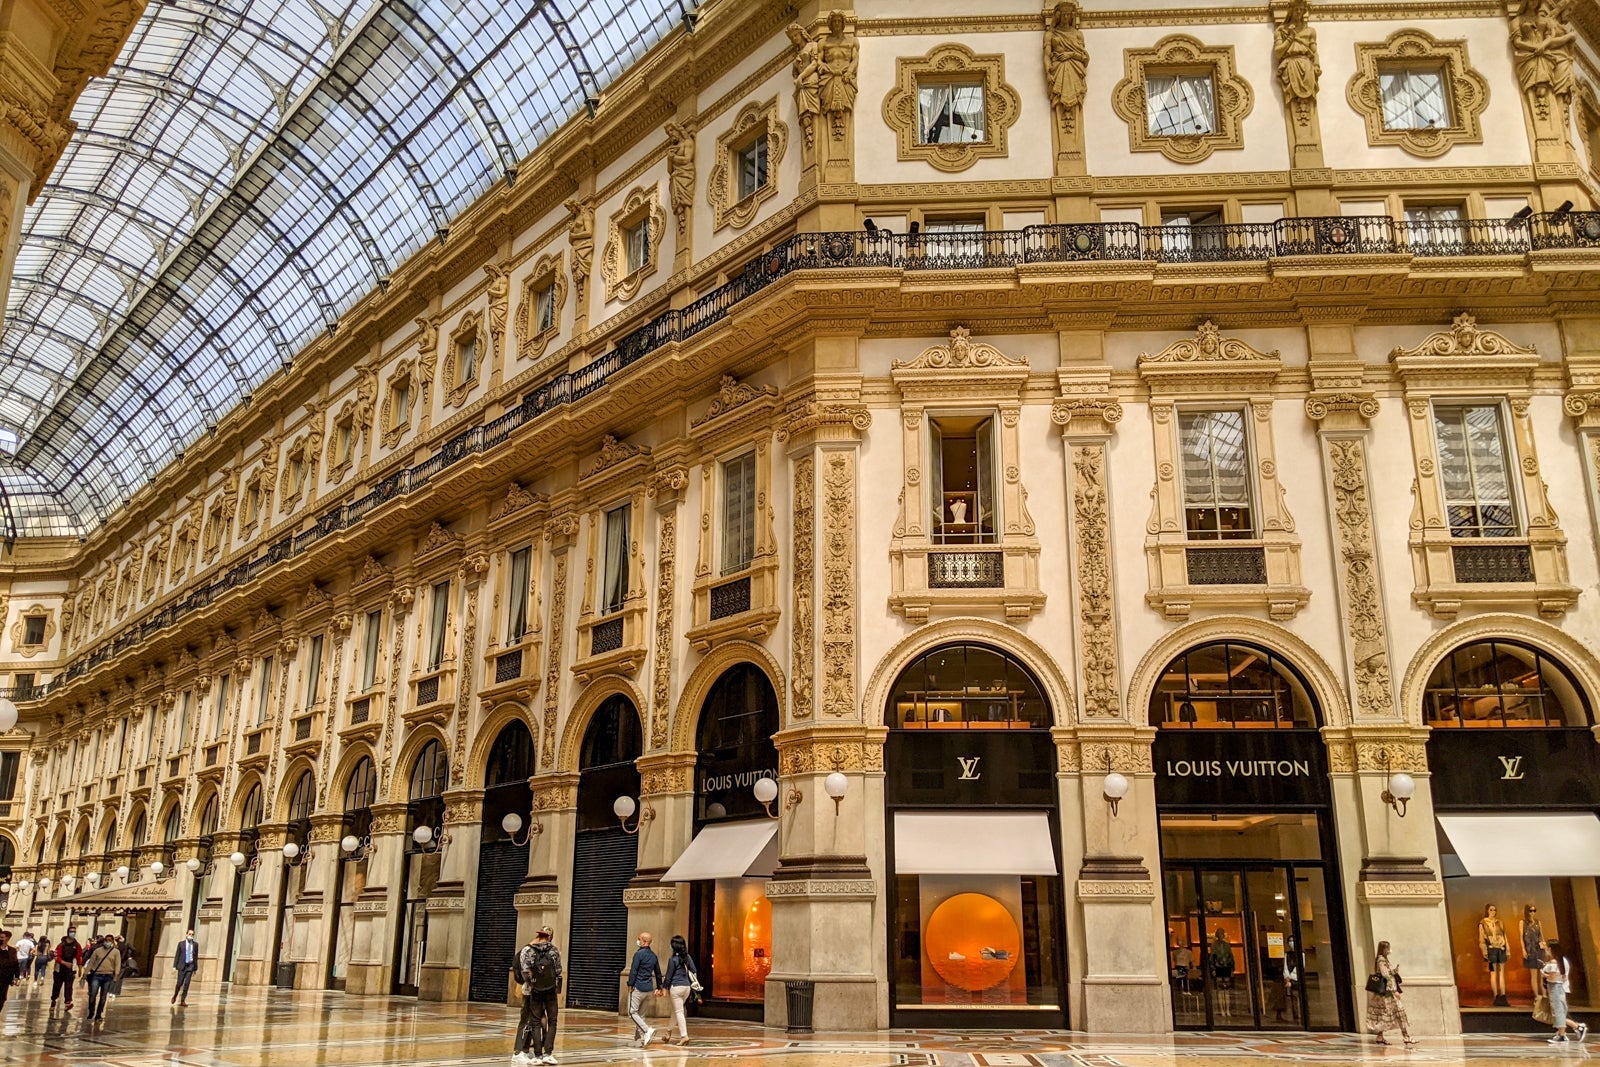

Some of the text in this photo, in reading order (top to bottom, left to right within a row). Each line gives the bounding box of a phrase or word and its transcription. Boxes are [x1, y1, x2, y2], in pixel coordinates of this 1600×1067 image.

[1166, 760, 1310, 777] LOUIS VUITTON
[702, 774, 732, 793] LOUIS
